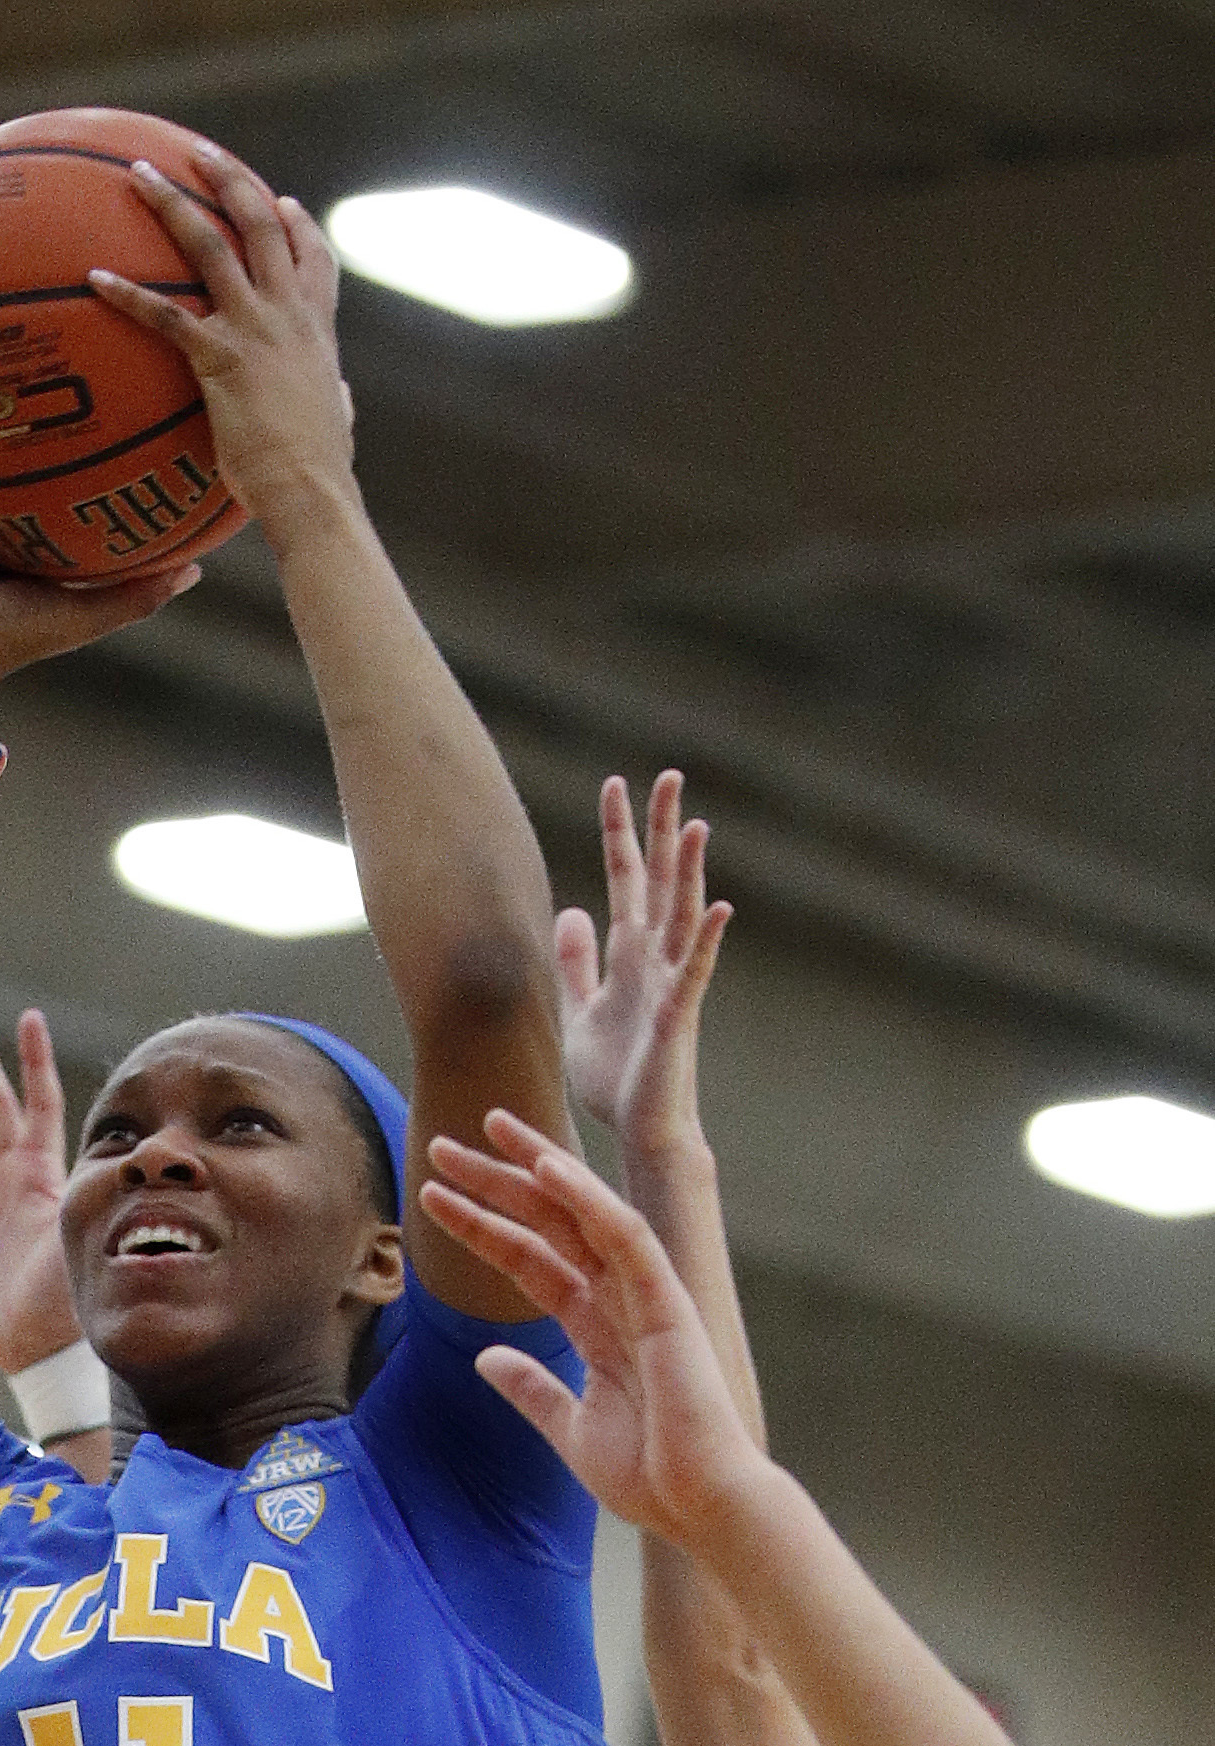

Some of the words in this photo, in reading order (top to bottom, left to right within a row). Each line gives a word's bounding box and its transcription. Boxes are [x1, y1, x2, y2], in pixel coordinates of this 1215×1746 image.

[71, 450, 220, 558] THE
[247, 1451, 323, 1484] JRW
[261, 1483, 319, 1522] PAC
[276, 1507, 310, 1532] 12
